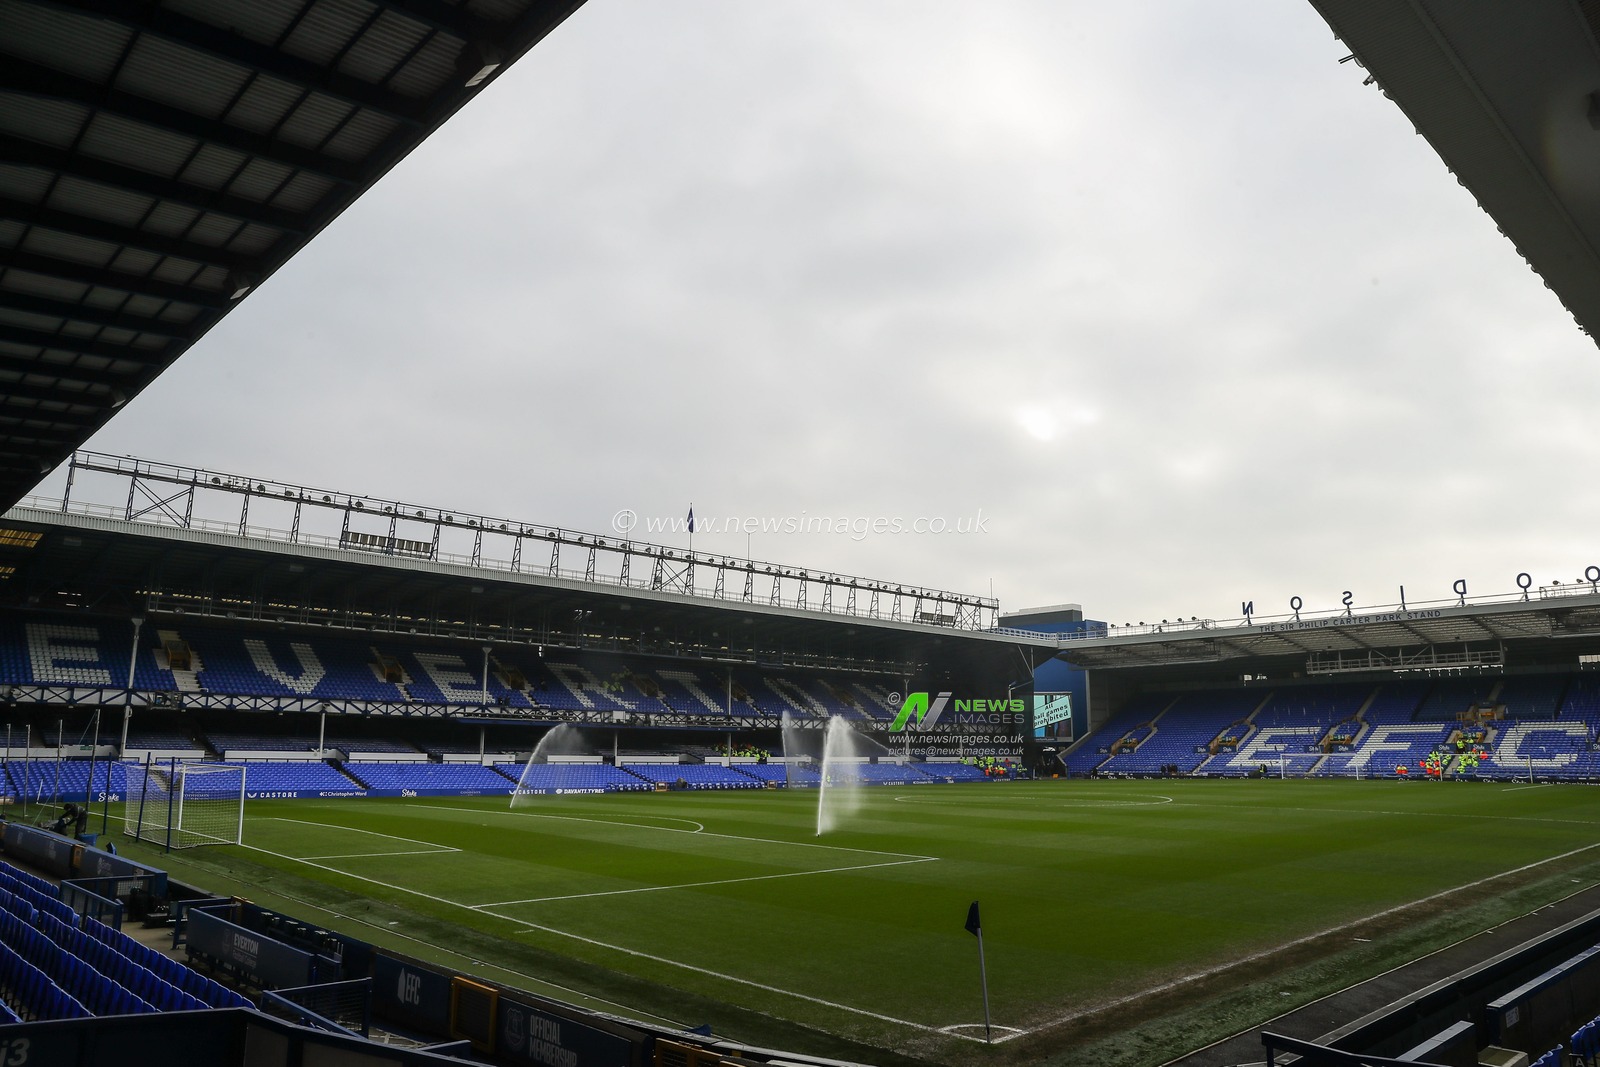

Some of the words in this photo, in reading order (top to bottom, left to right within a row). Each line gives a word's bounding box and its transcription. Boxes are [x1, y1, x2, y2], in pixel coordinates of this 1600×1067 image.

[1280, 623, 1294, 631] SIR
[1298, 620, 1328, 629] PHILIP
[1333, 616, 1370, 626] CARTER
[1375, 613, 1402, 622] PARK
[1407, 610, 1441, 619] STAND
[1044, 703, 1053, 711] All
[1046, 704, 1068, 717] games
[98, 791, 119, 802] Sake
[401, 788, 417, 798] Stake
[233, 933, 259, 955] EVERTON
[406, 973, 421, 1006] EFC
[529, 1014, 562, 1046] OFFICIAL
[529, 1036, 578, 1067] MEMBERSHIP
